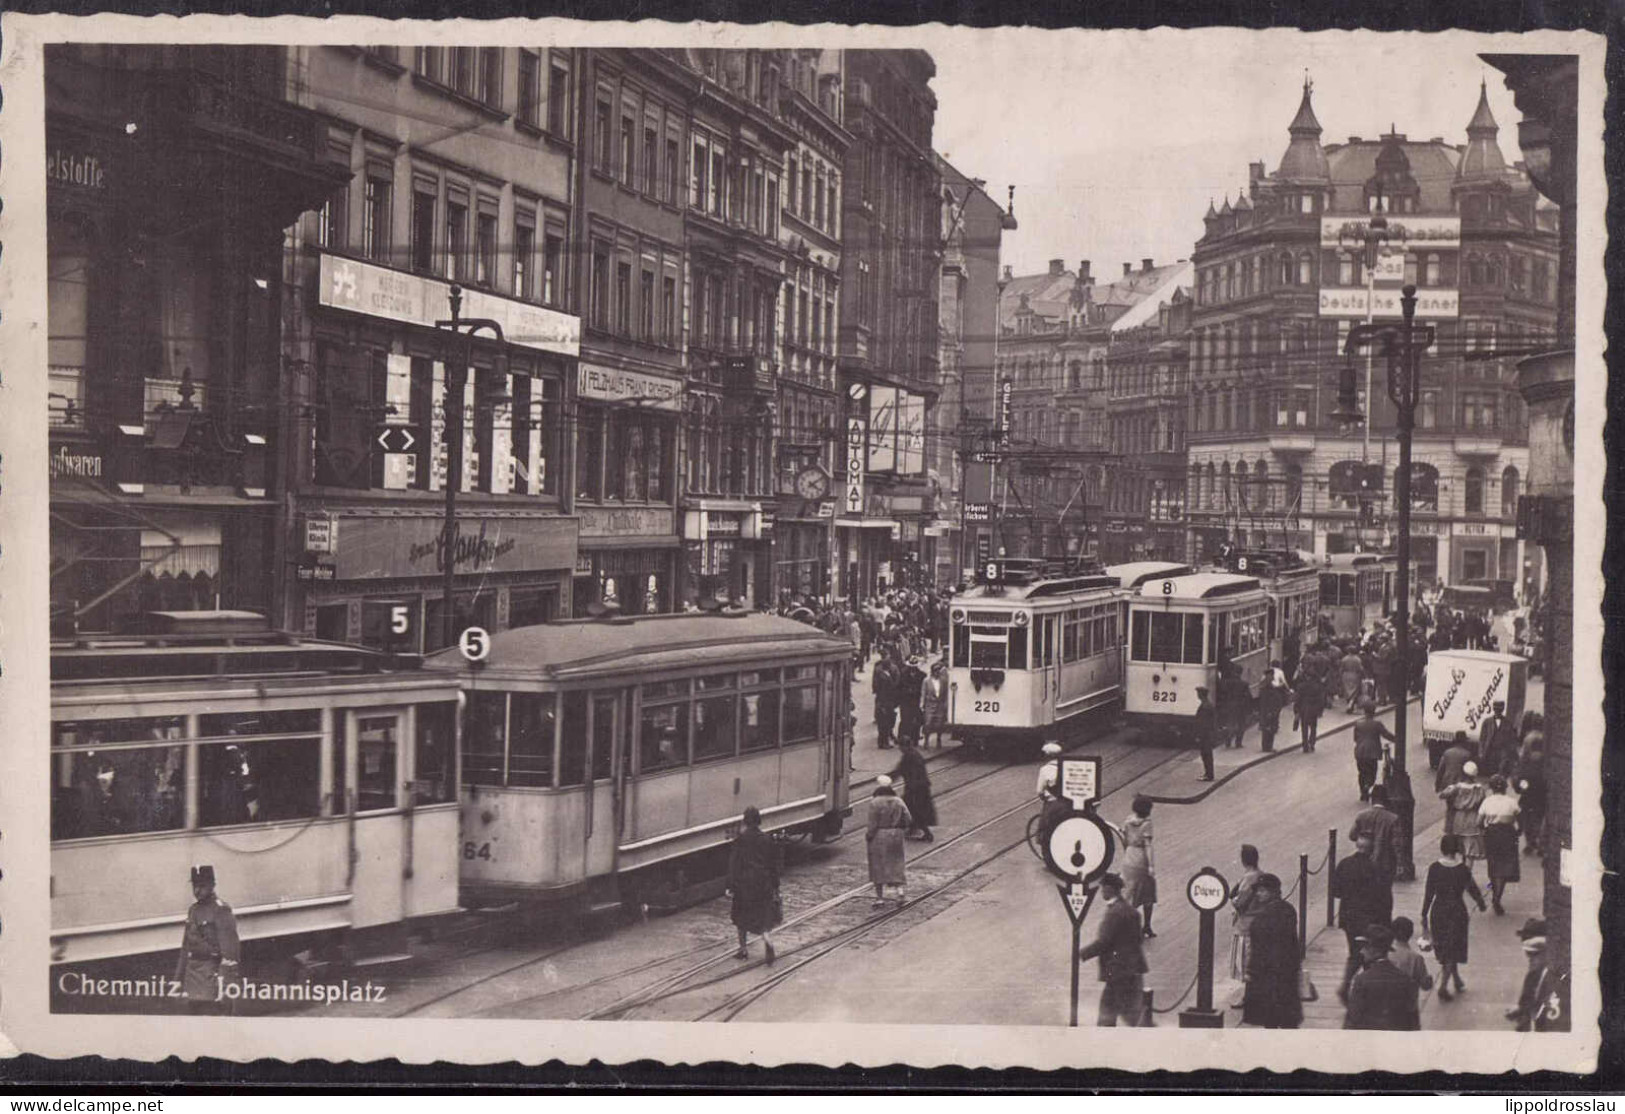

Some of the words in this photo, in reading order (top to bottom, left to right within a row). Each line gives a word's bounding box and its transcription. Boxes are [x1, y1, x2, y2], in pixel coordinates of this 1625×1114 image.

[1320, 294, 1394, 309] Deutshe
[849, 420, 861, 511] AUTOMAT
[986, 563, 998, 579] 8
[1238, 557, 1247, 570] 8
[1162, 582, 1172, 595] 8
[391, 606, 409, 634] 5
[465, 631, 484, 658] 5
[1152, 691, 1177, 702] 623
[1433, 669, 1466, 720] Jacobs
[974, 700, 1000, 712] 220
